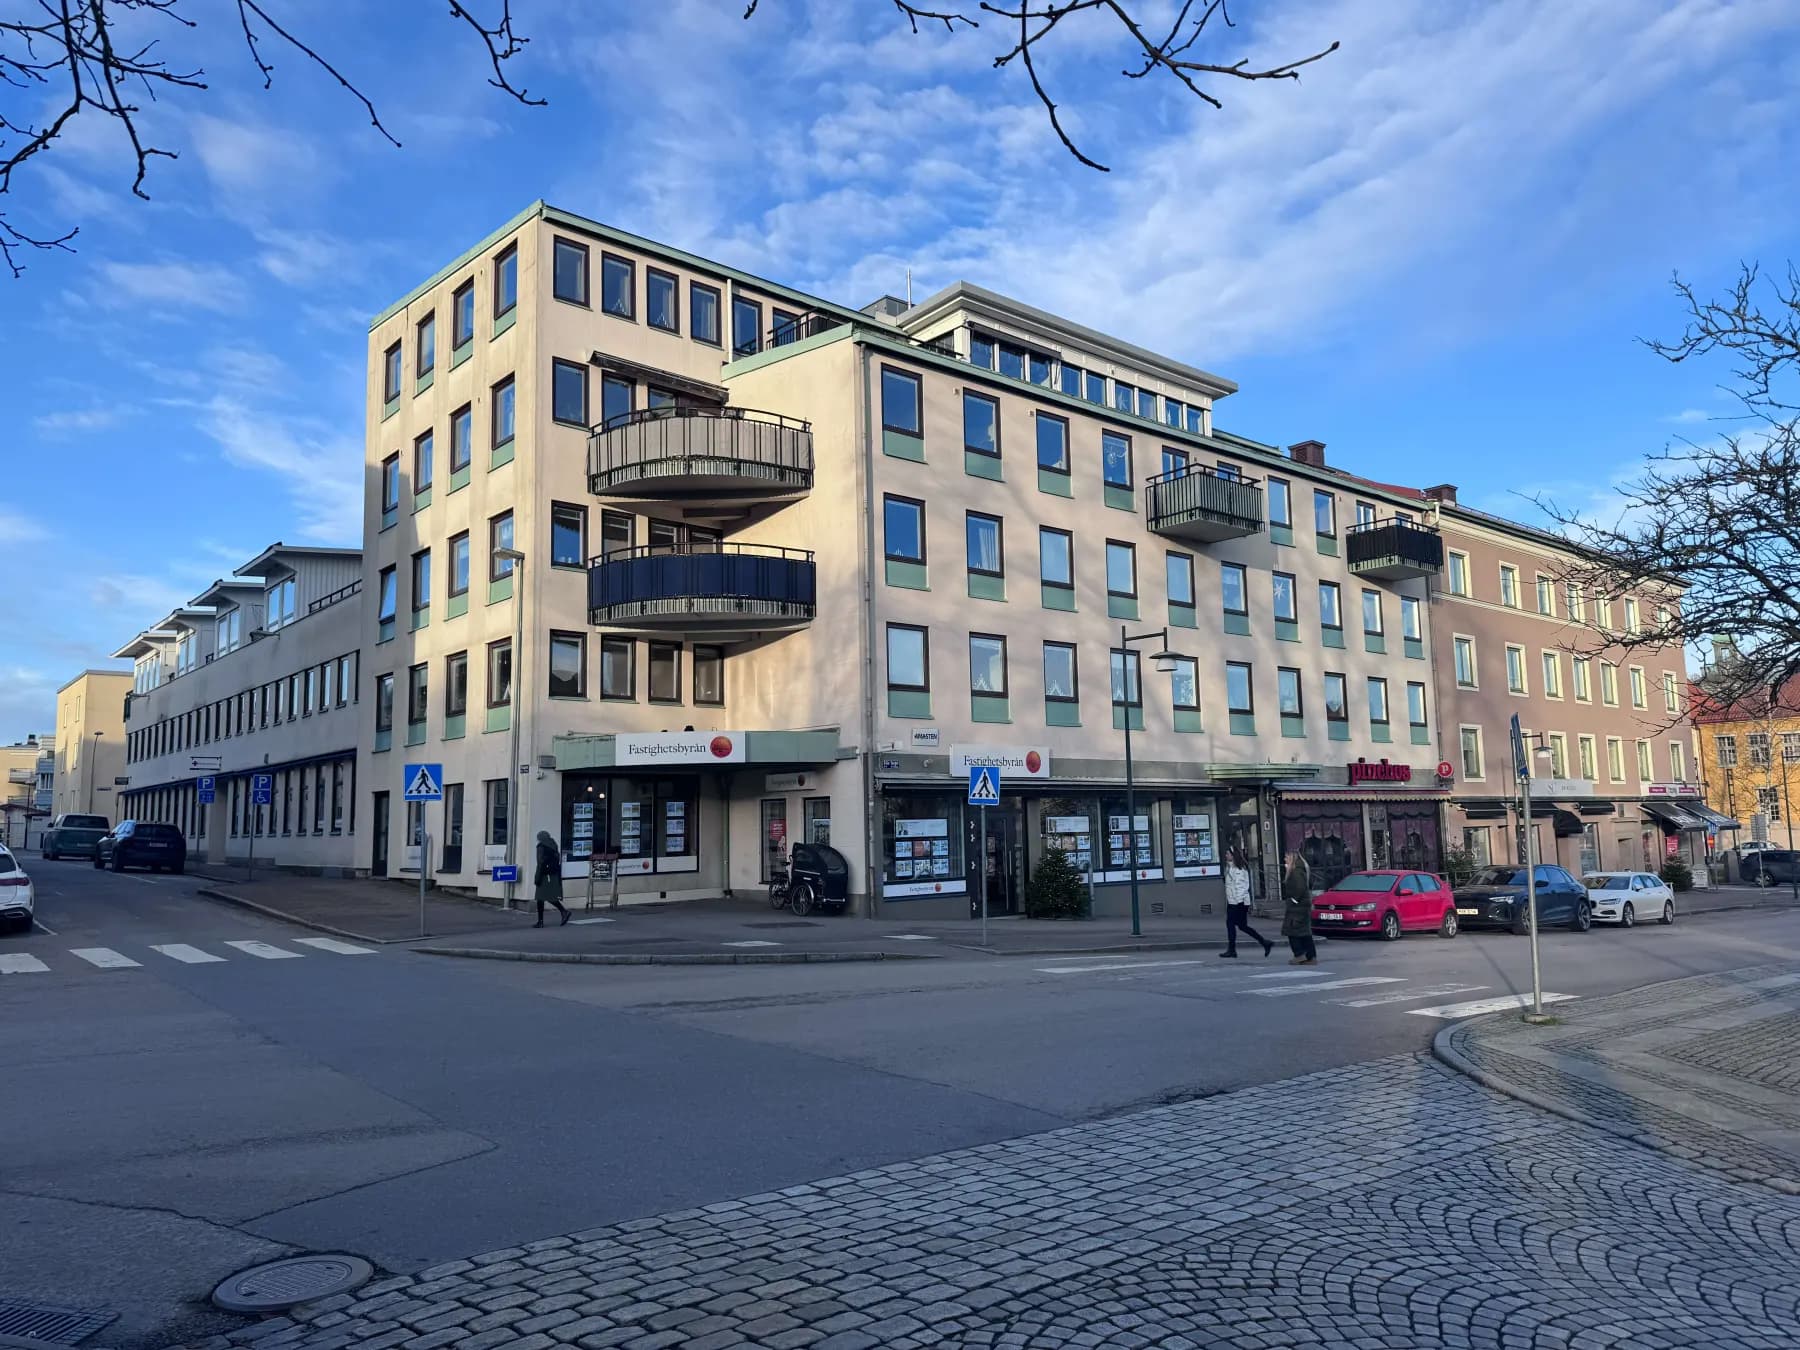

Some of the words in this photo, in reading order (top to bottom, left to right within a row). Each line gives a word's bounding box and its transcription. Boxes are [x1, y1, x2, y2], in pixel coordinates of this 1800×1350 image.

[628, 743, 706, 757] Fastighetsbyrån
[964, 754, 1024, 770] Fastighetsbyrån
[202, 778, 211, 789] P
[259, 776, 268, 788] P
